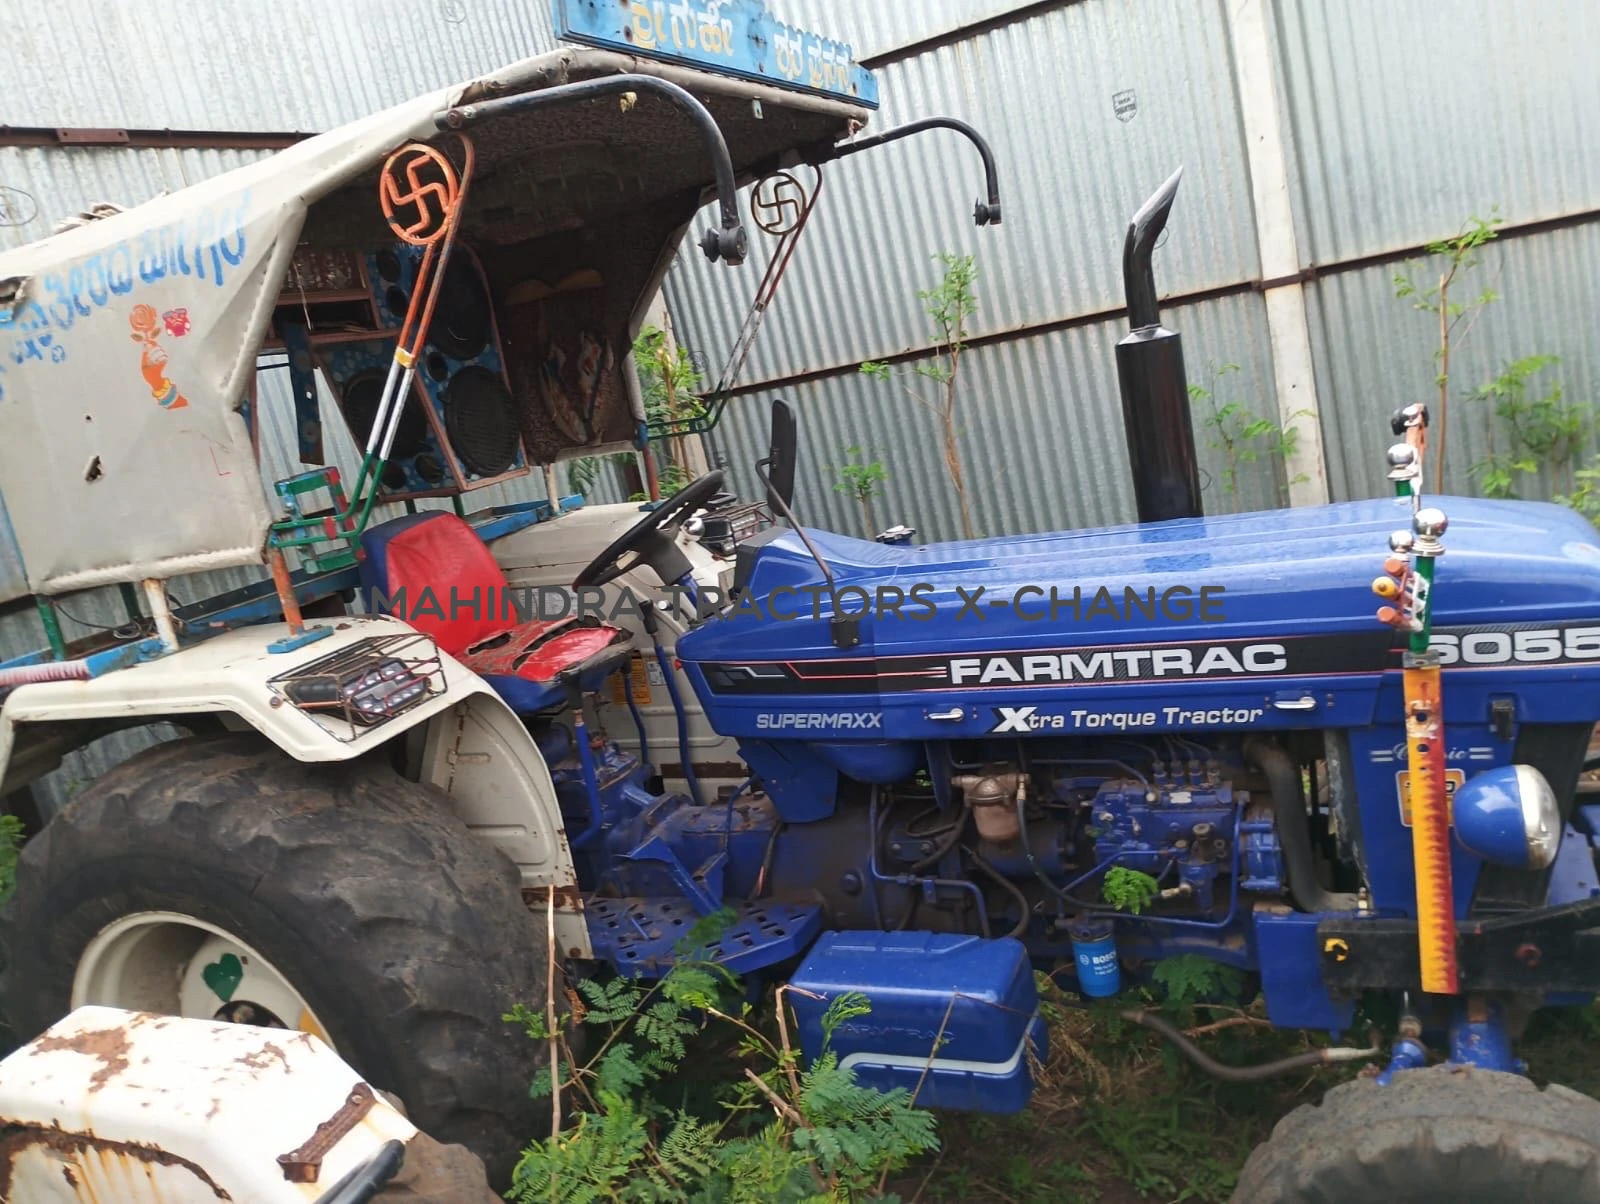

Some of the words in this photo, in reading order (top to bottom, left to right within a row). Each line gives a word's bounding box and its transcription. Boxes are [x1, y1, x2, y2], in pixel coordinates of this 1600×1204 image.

[950, 645, 1287, 684] FARMTRAC
[755, 712, 883, 729] SUPERMAXX
[991, 706, 1065, 733] Xtra
[1070, 709, 1157, 731] Torque
[1162, 706, 1264, 726] Tractor
[834, 1023, 958, 1044] ARMTRAC
